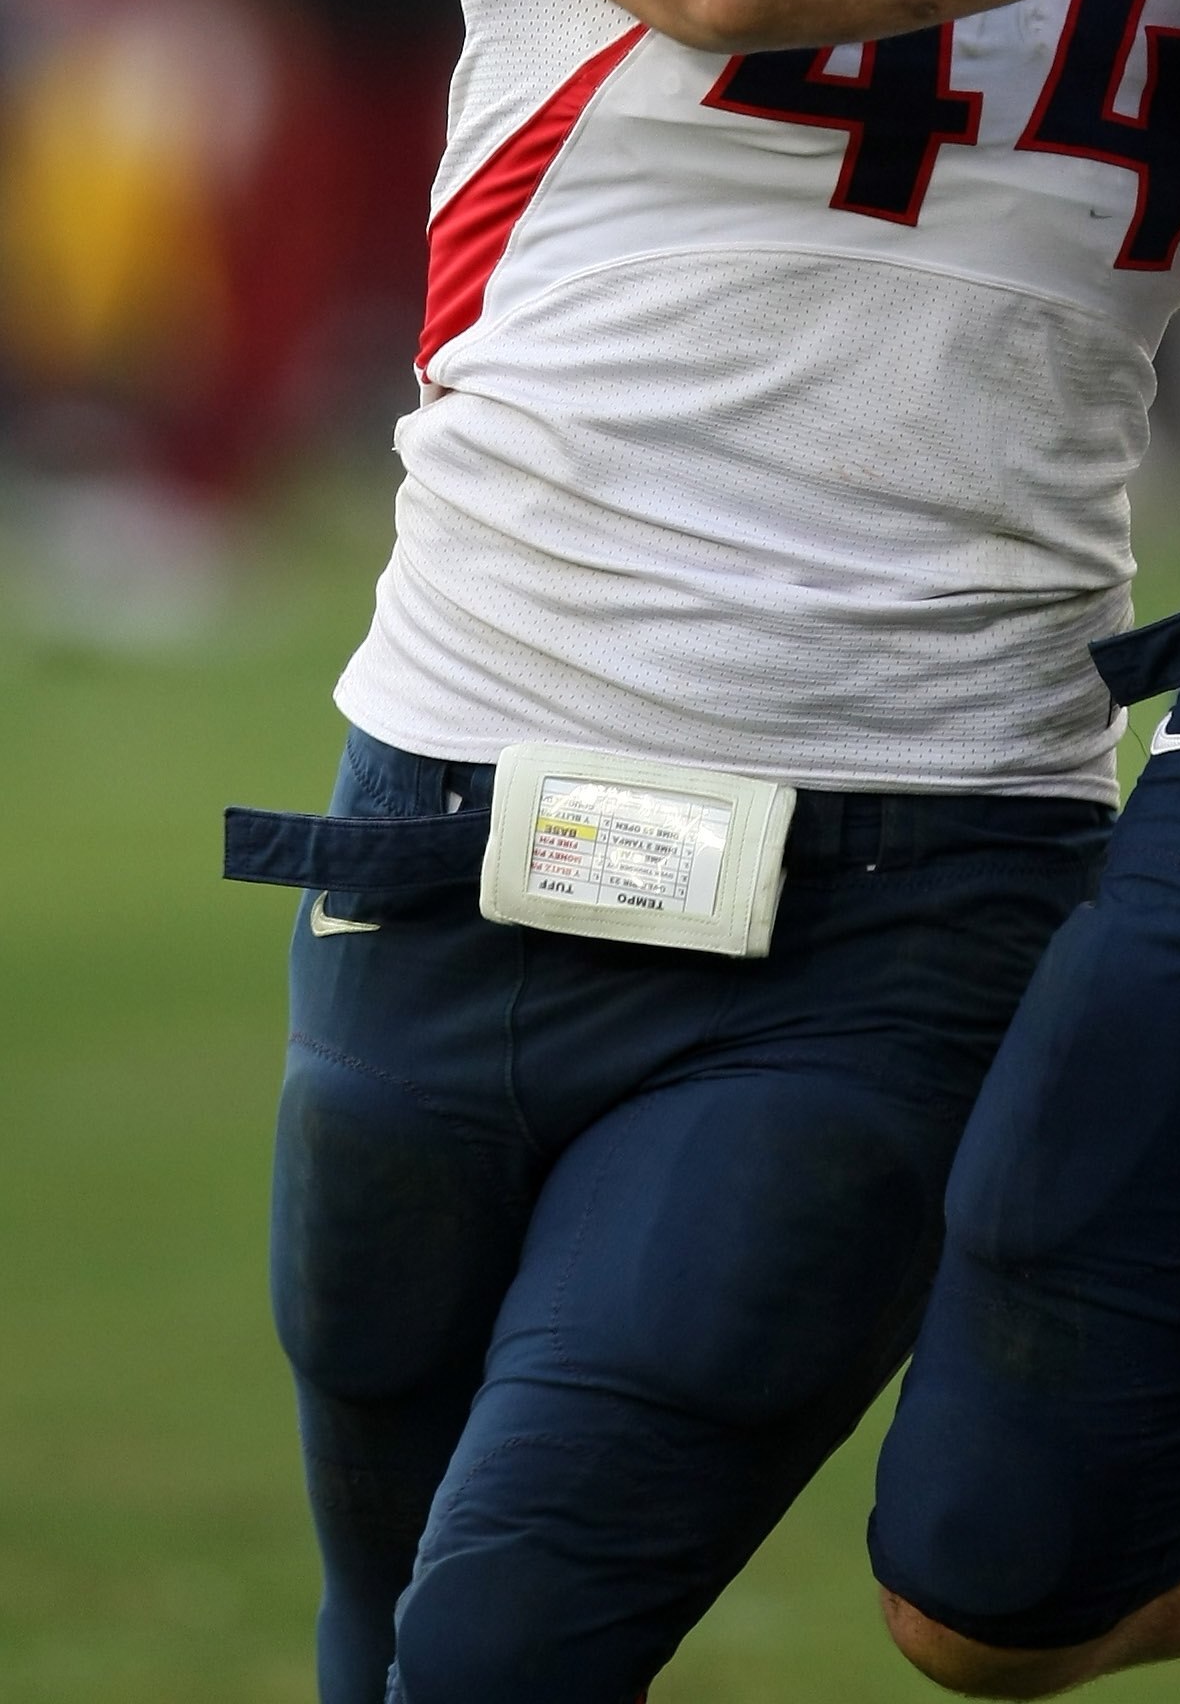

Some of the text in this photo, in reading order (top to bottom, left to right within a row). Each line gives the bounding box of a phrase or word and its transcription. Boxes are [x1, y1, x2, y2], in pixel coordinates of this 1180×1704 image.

[544, 824, 577, 838] BASE
[557, 839, 579, 850] FIRE
[539, 879, 574, 895] TUFF
[617, 893, 664, 911] TEMPO
